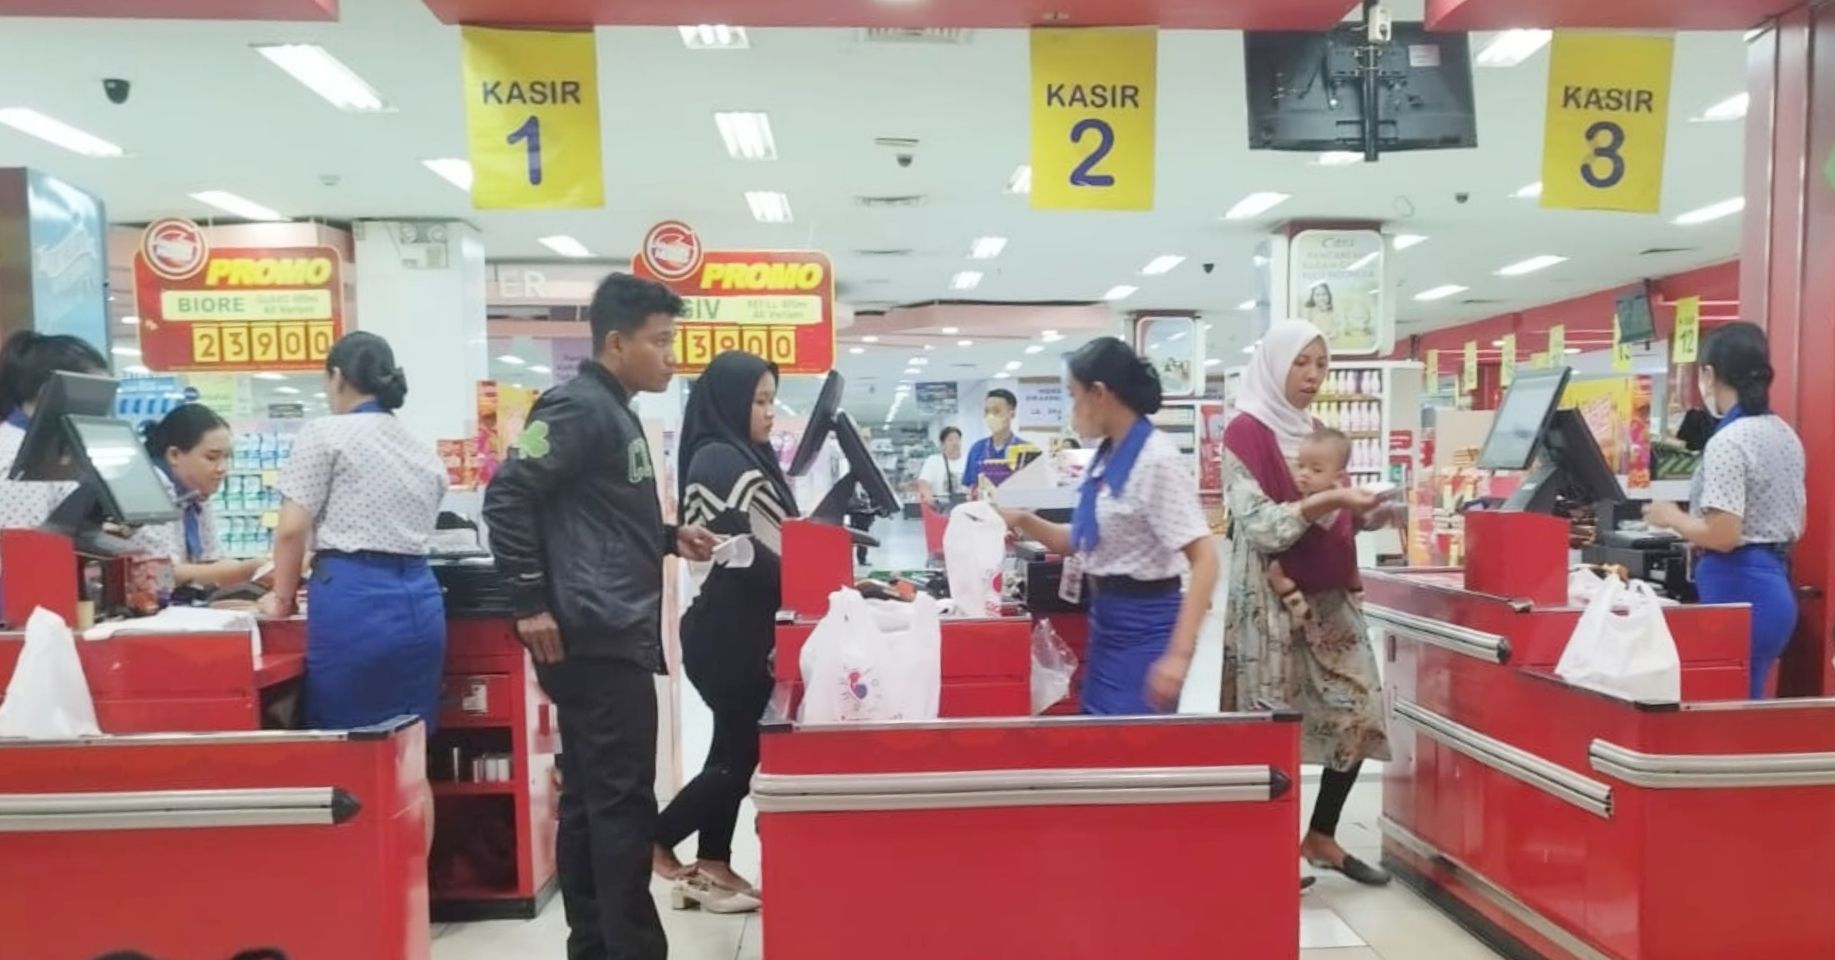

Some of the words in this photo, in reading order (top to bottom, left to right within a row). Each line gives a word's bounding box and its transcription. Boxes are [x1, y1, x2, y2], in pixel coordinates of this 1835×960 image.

[482, 80, 582, 105] KASIR
[1046, 83, 1140, 109] KASIR
[1562, 85, 1654, 114] KASIR
[506, 115, 542, 186] 1
[1069, 118, 1115, 187] 2
[1580, 121, 1625, 189] 3
[205, 257, 333, 286] PROMO
[700, 262, 824, 290] PROMO
[178, 297, 246, 313] BIORE
[199, 331, 330, 358] 23900
